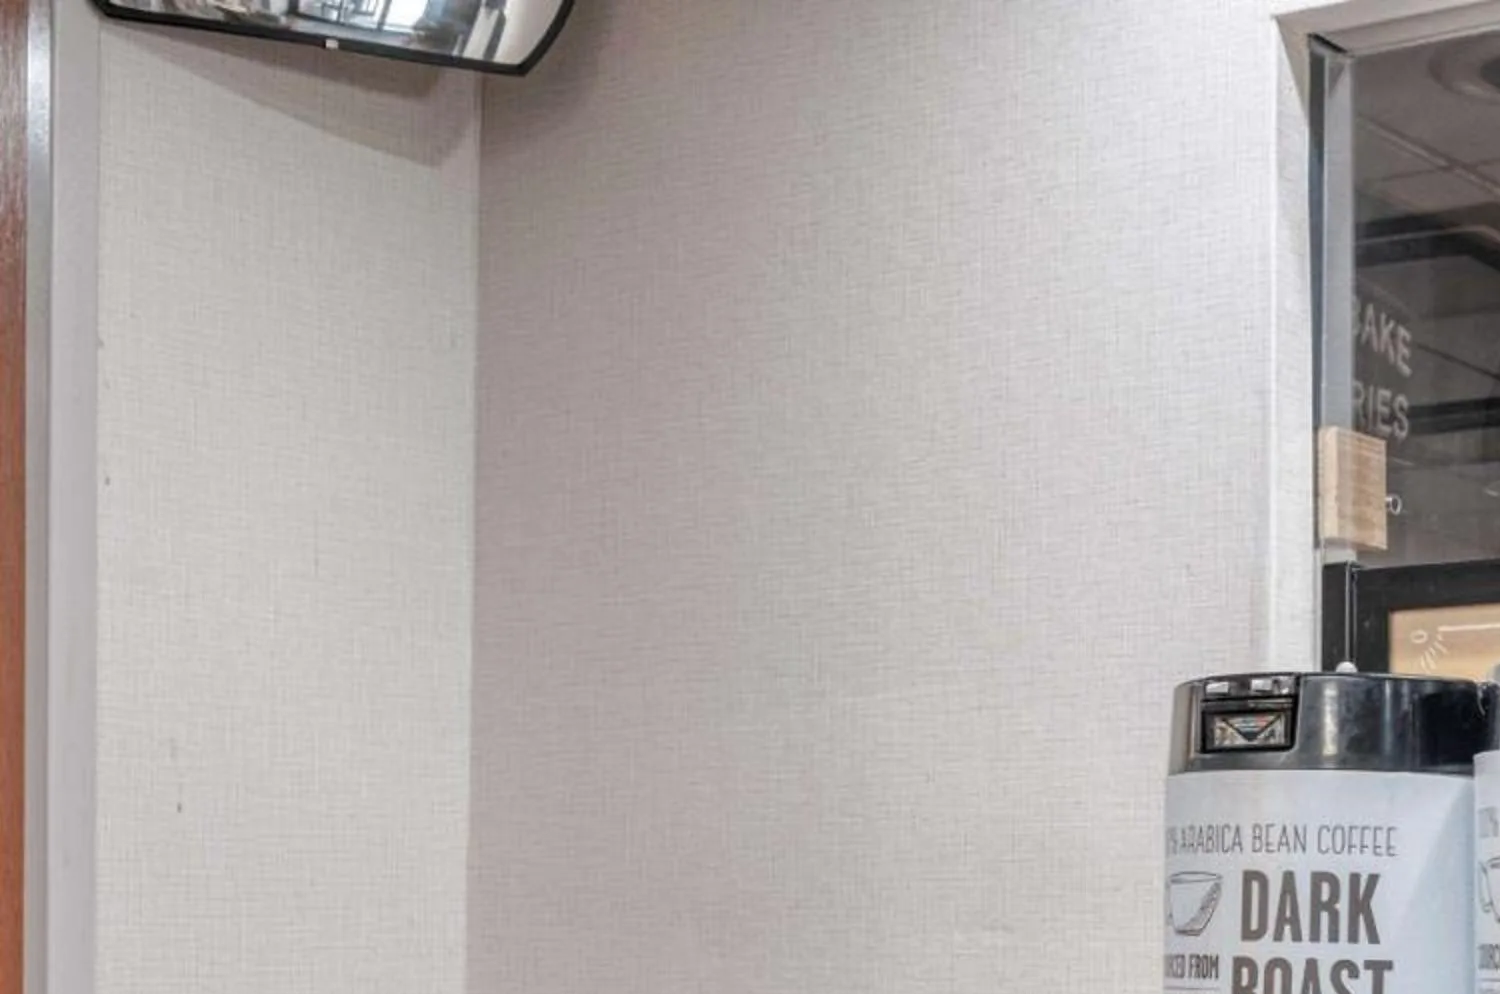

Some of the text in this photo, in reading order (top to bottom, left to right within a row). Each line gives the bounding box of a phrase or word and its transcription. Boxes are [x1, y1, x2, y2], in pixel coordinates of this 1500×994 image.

[1250, 823, 1308, 855] BEAN
[1317, 825, 1399, 858] COFFEE
[1240, 869, 1382, 945] DARK
[1189, 953, 1220, 979] FROM
